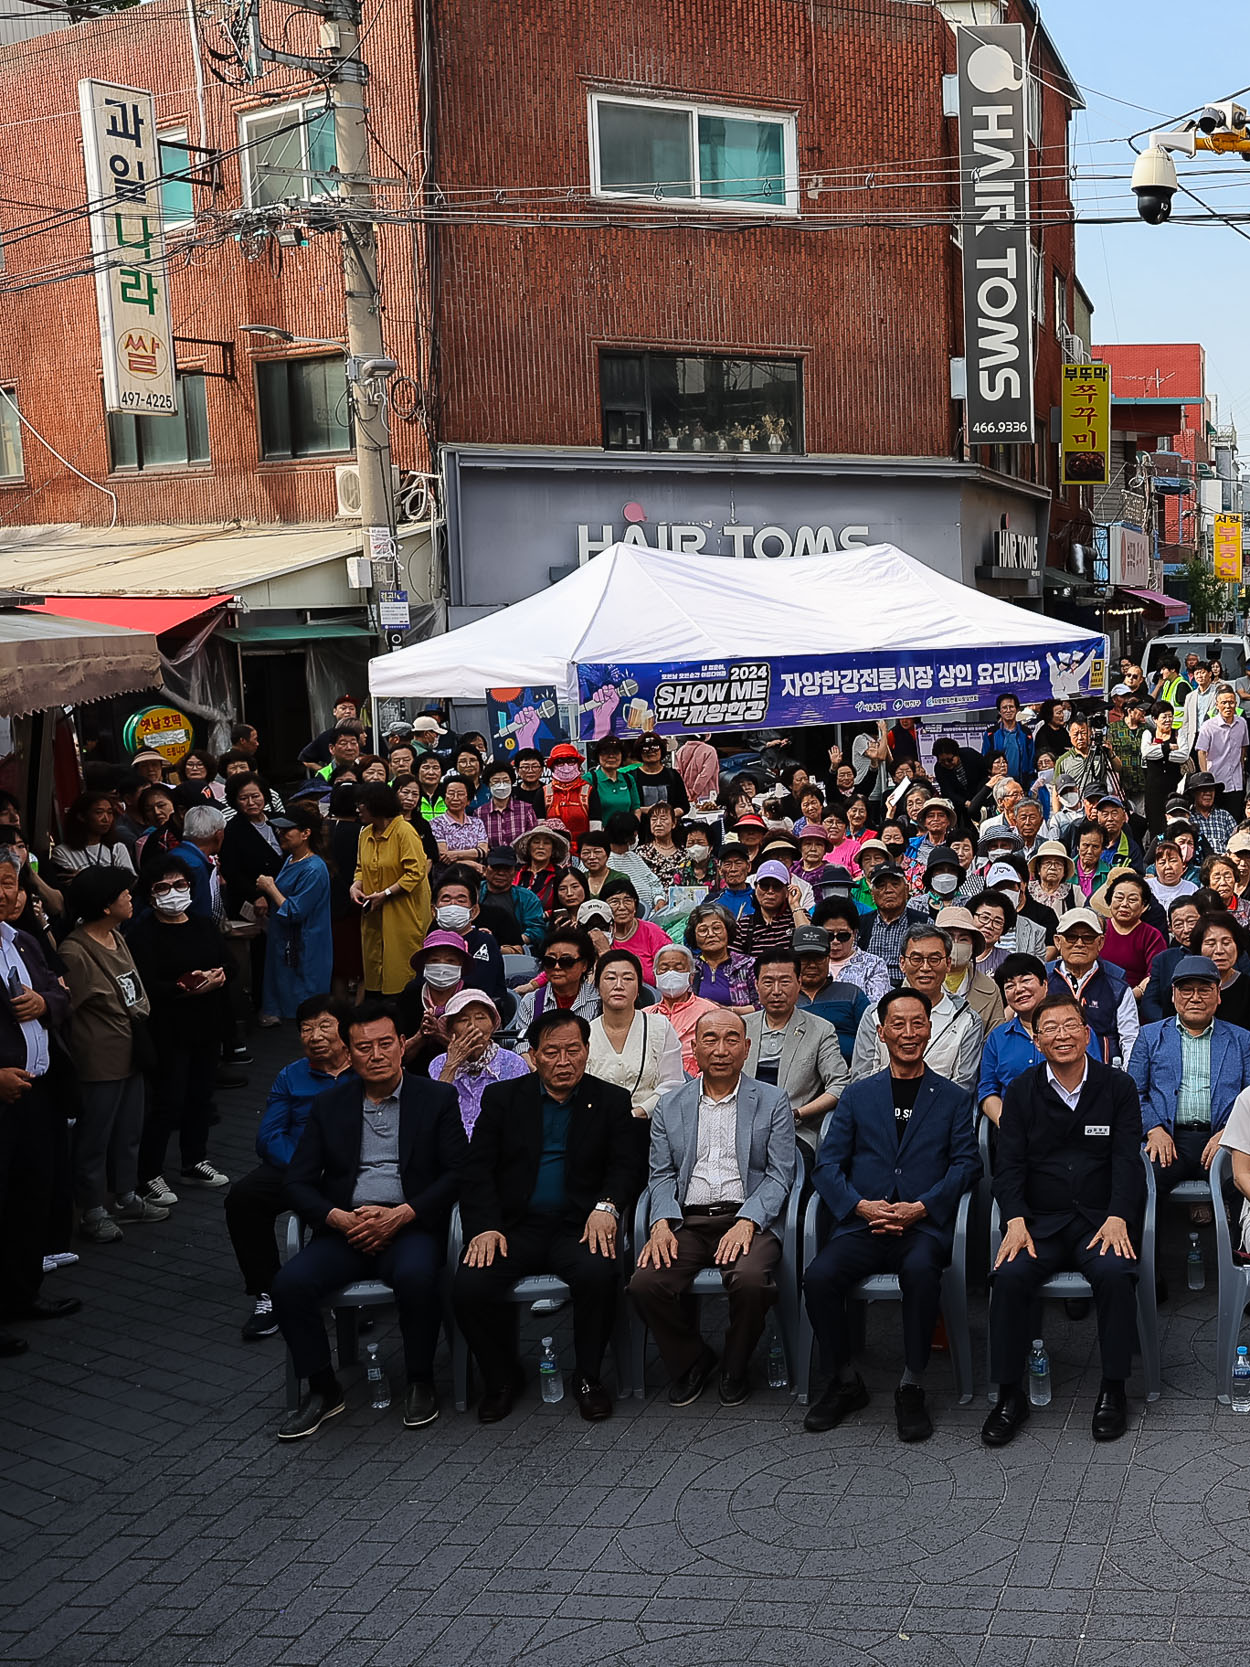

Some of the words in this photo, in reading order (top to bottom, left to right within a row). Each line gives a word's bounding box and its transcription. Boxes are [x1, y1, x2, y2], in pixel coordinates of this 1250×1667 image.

[972, 105, 1016, 238] HAIR
[105, 98, 159, 316] 과일나라
[975, 248, 1021, 401] TOMS
[124, 333, 160, 375] 쌀
[1065, 367, 1108, 382] 부뚜막
[121, 391, 173, 409] 497-4225
[972, 421, 1028, 433] 466.9336
[578, 524, 707, 567] HAIR
[723, 525, 869, 560] TOMS
[1018, 534, 1038, 570] TOMS
[730, 665, 768, 681] 2024
[780, 665, 934, 697] 자양한강전통시장
[938, 663, 972, 688] 상인
[977, 660, 1042, 686] 요리대회
[657, 683, 730, 706] SHOW
[730, 680, 768, 701] ME
[140, 714, 183, 732] 옛날호떡
[658, 706, 689, 720] THE
[684, 700, 766, 725] 자양한강
